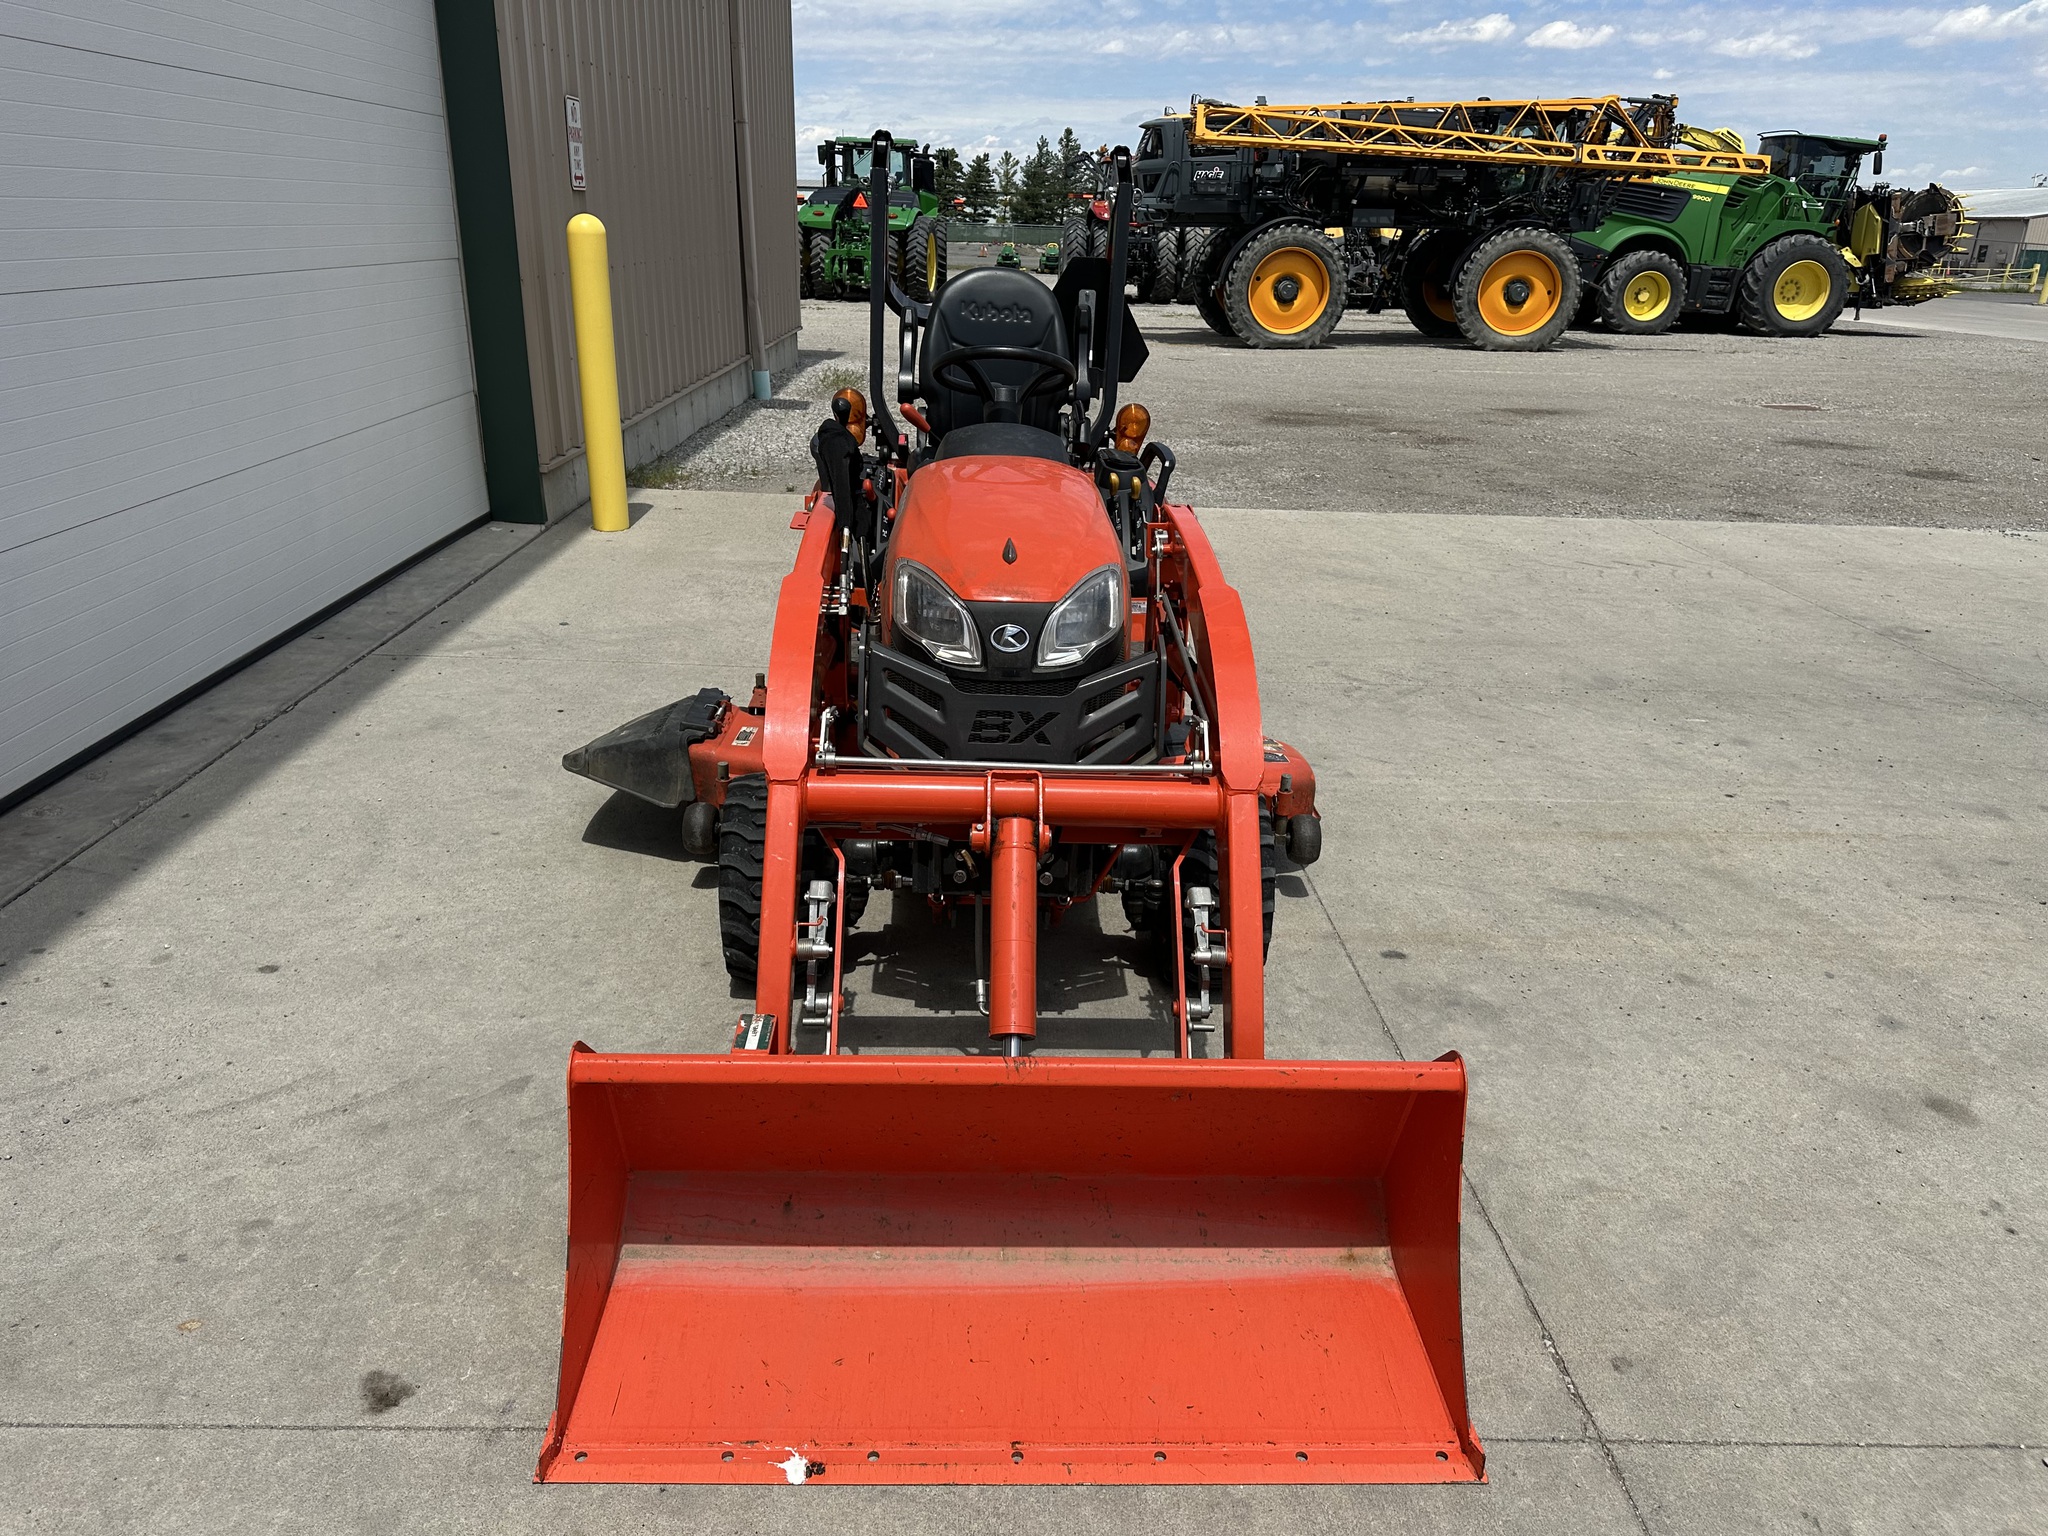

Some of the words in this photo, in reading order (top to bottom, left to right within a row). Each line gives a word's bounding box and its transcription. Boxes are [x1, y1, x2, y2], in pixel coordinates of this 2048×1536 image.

[571, 106, 578, 123] NO
[569, 126, 582, 143] PARKING
[1655, 177, 1674, 186] JOHN
[1674, 179, 1696, 190] DEERE
[960, 300, 1032, 323] Kubota
[967, 709, 1061, 746] BX
